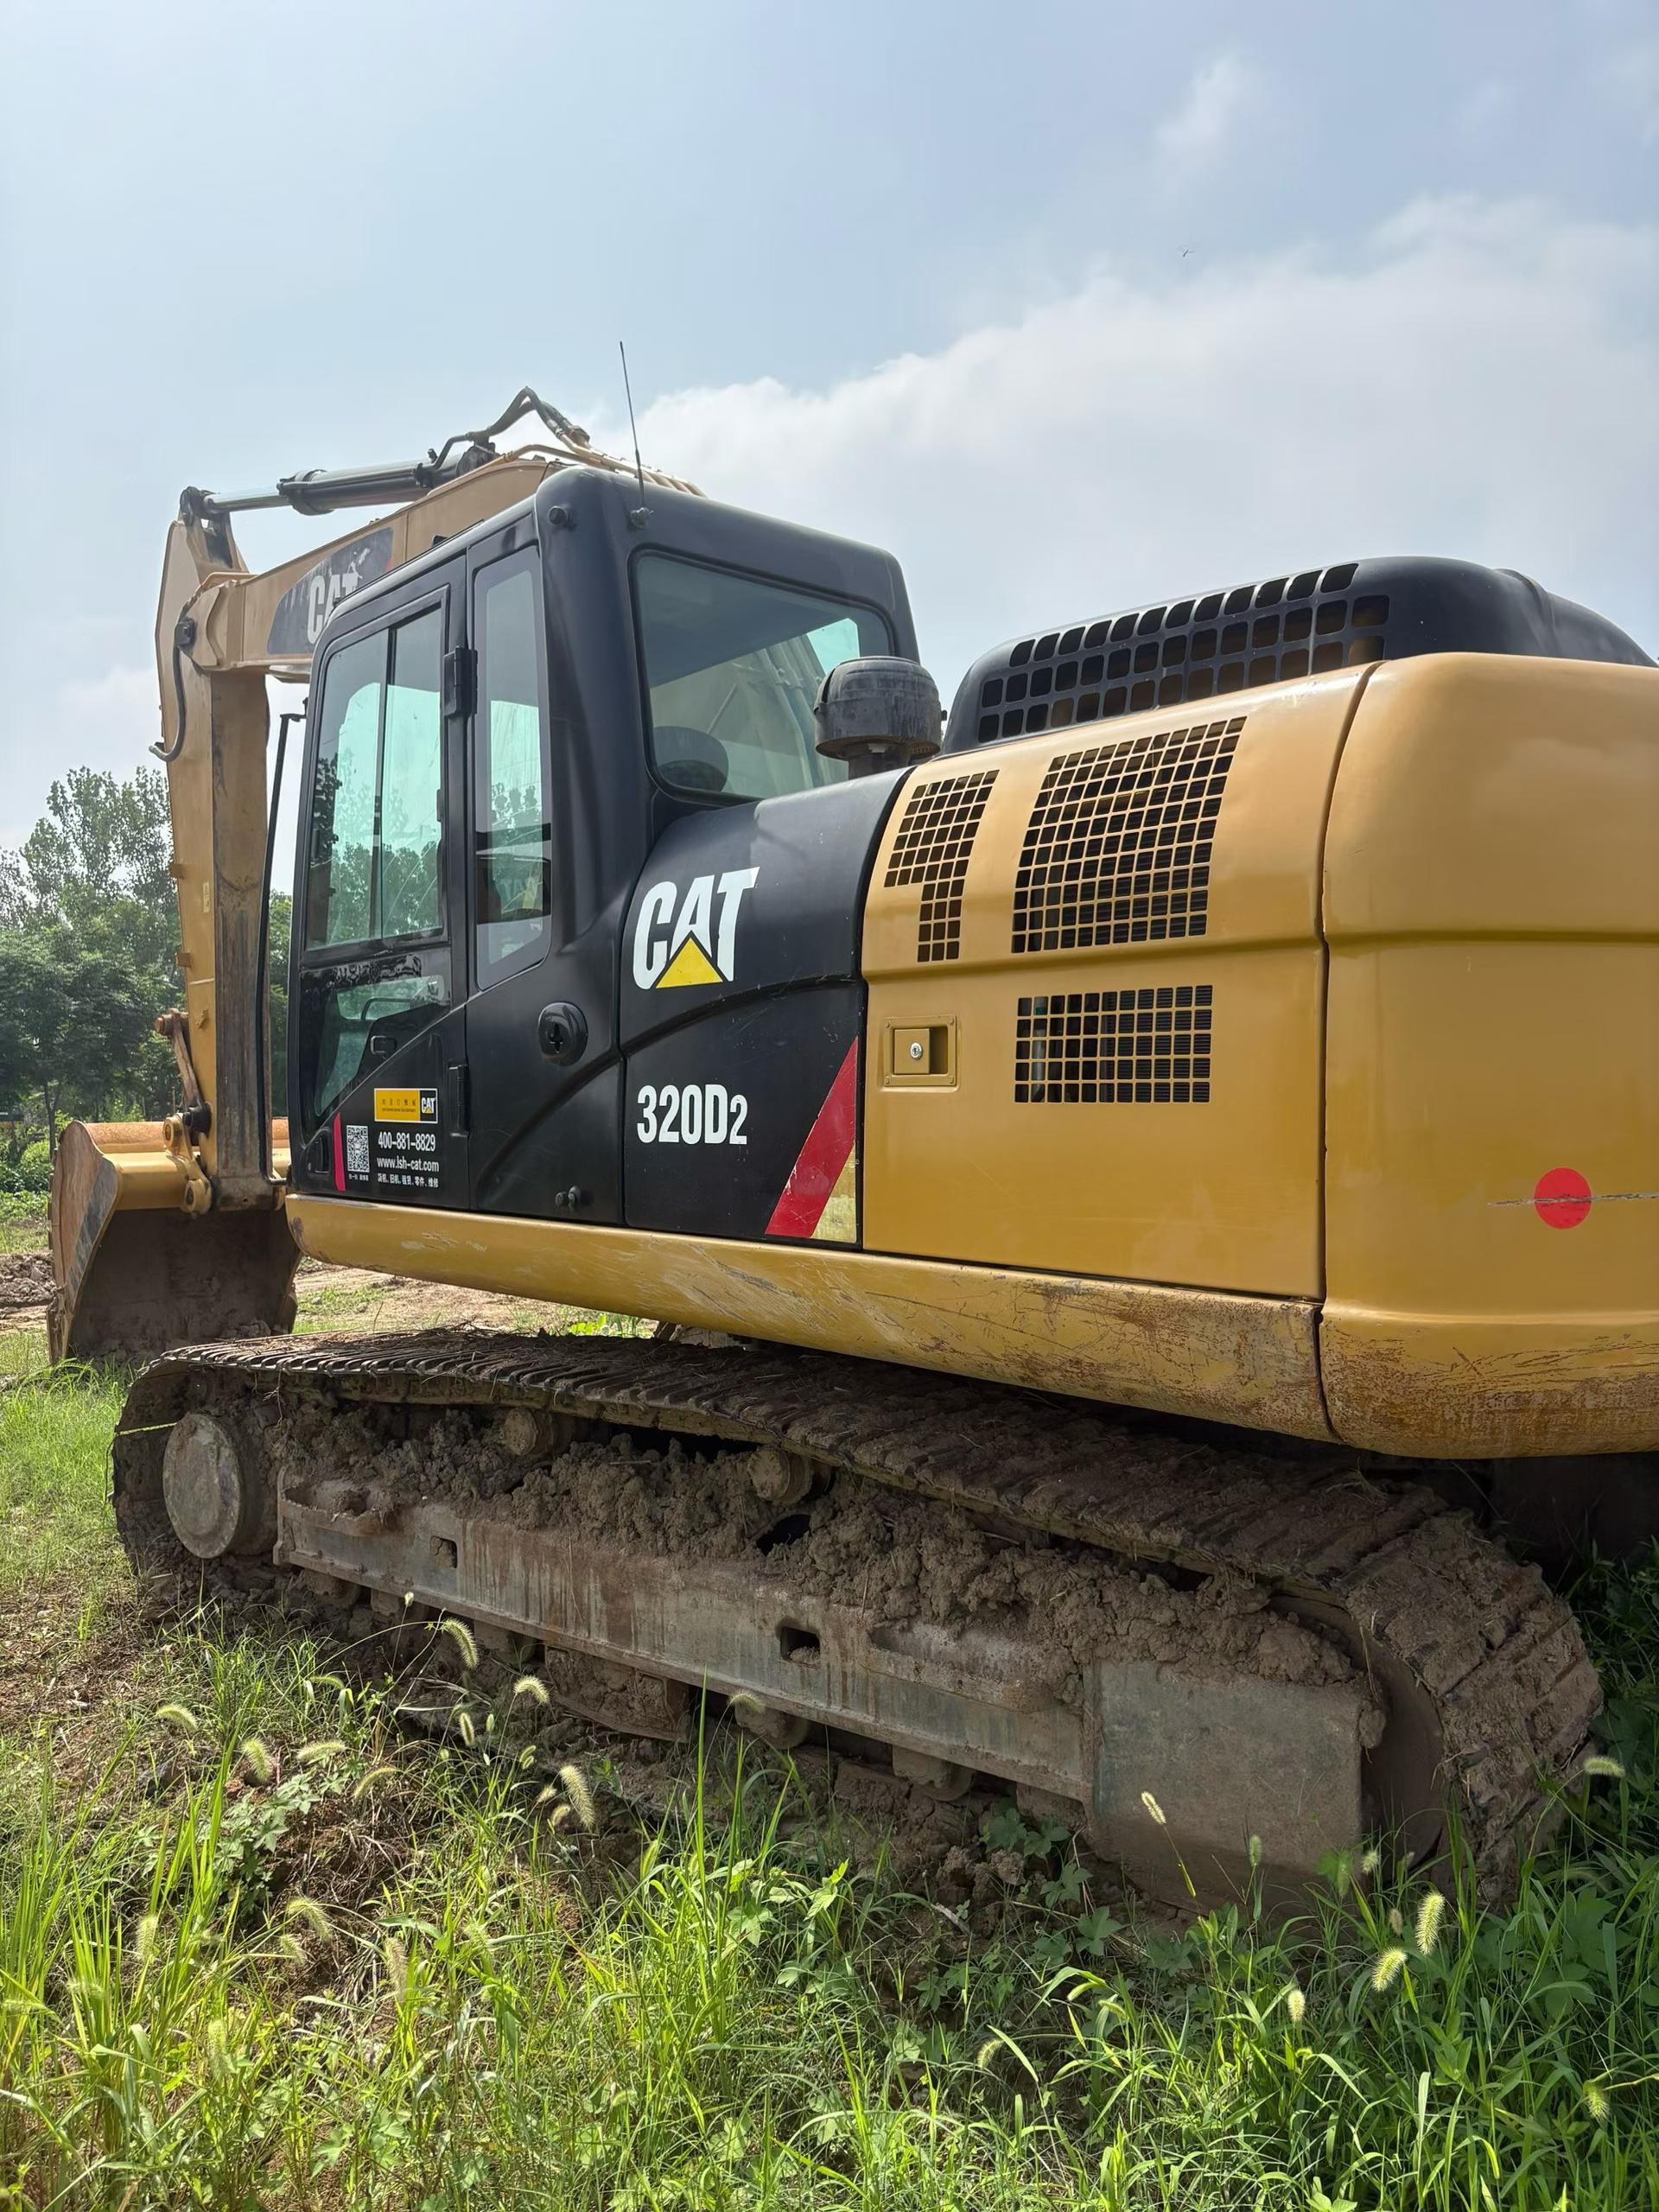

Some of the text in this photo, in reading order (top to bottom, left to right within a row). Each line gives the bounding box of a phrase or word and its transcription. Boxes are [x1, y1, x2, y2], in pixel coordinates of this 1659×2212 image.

[632, 867, 760, 990] CAT
[421, 1097, 435, 1114] CAT
[637, 1084, 748, 1145] 320D2
[378, 1131, 435, 1152] 400-881-8829
[377, 1155, 440, 1173] www.lsh-cat.com
